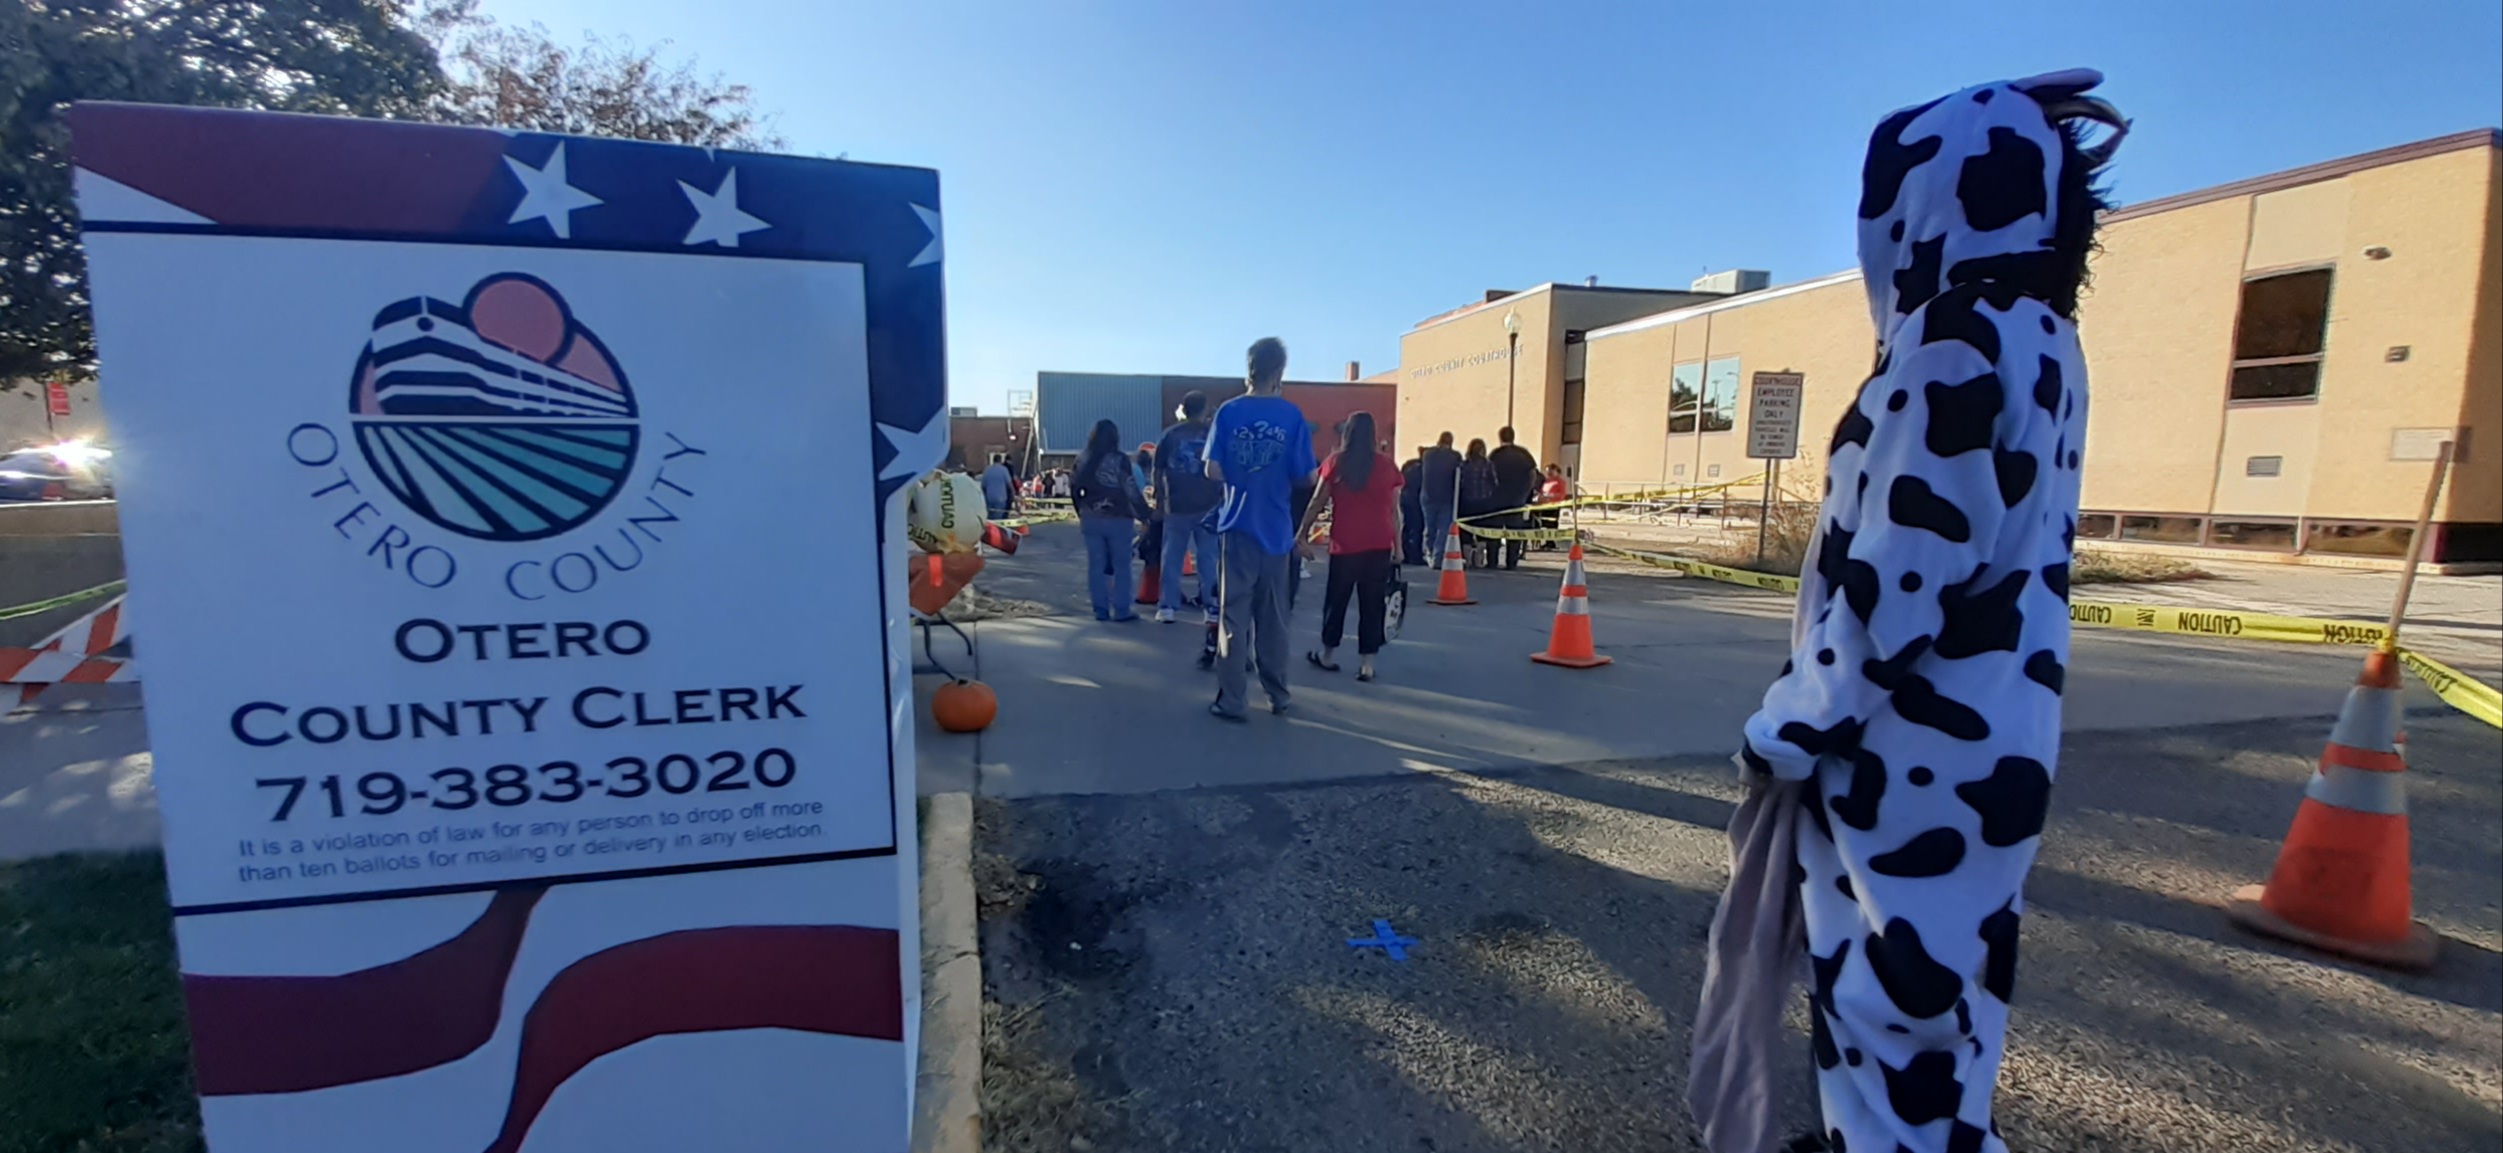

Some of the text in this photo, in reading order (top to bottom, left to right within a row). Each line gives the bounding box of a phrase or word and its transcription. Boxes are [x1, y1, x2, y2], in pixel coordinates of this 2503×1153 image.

[1757, 388, 1794, 397] EMPLOYEE
[287, 423, 707, 600] OTERO COUNTY
[393, 618, 651, 663] OTERO
[2069, 604, 2112, 623] CAUTIO
[2178, 612, 2242, 635] CAUTION
[230, 684, 807, 747] COUNTY CLERK
[255, 747, 796, 822] 719-383-3020
[239, 800, 824, 857] It is a violation of law for any person to drop off more
[239, 823, 827, 882] than ten ballots for mailing or delivery in any election.
